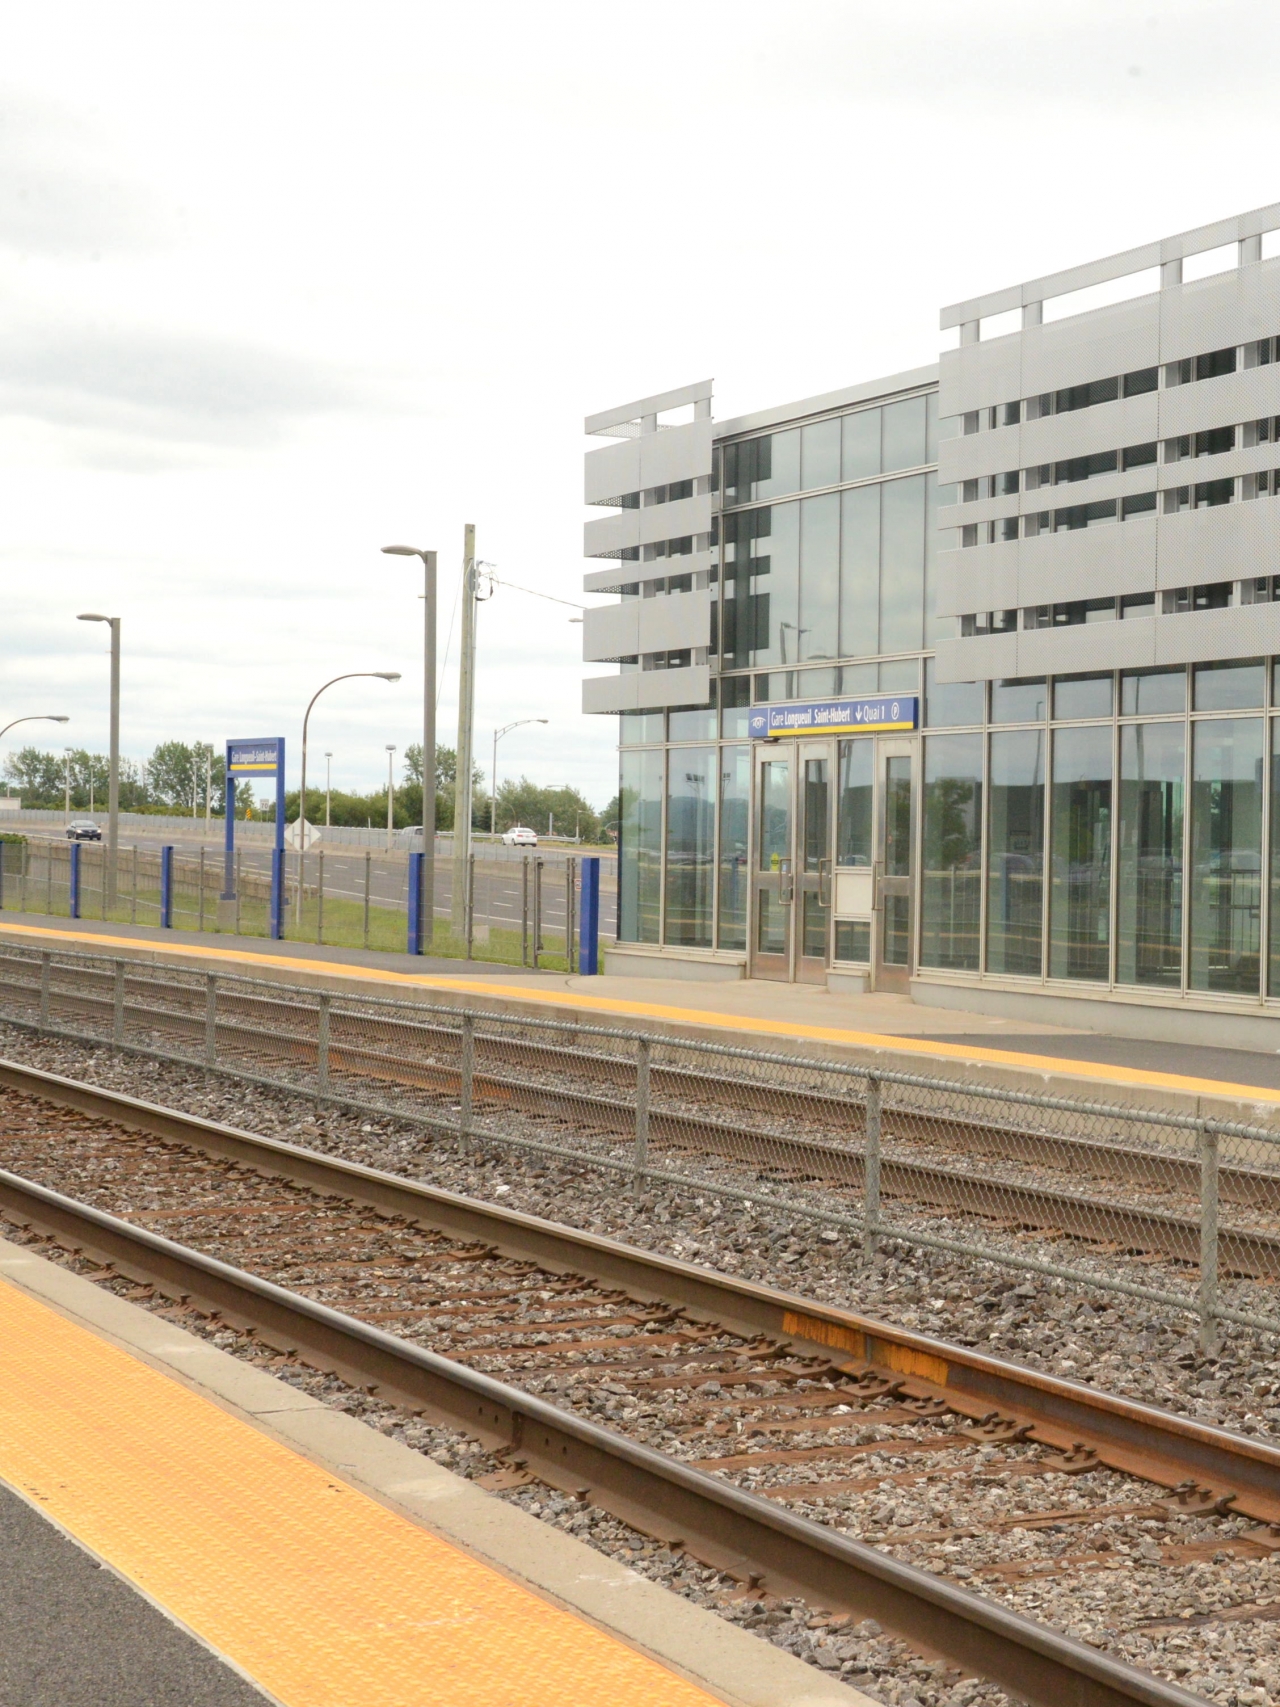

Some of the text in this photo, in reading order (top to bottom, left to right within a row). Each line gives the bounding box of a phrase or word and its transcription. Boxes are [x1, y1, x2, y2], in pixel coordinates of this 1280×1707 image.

[771, 706, 850, 728] Gare Longueuil Saint-Hubert
[863, 705, 885, 722] Quai 1
[231, 751, 239, 763] Gare
